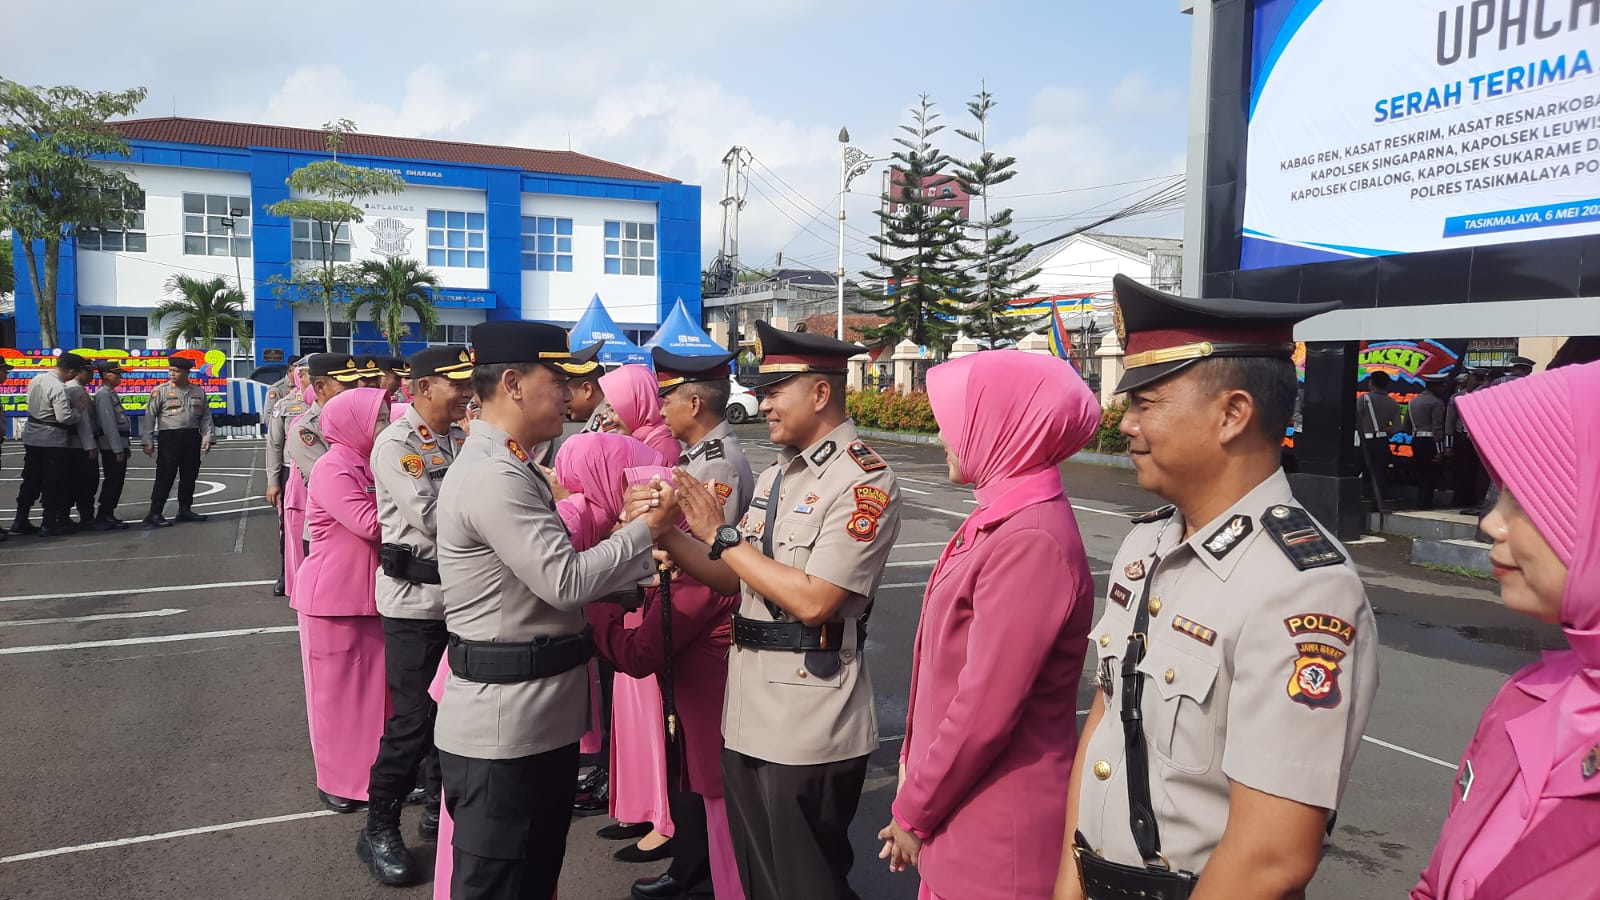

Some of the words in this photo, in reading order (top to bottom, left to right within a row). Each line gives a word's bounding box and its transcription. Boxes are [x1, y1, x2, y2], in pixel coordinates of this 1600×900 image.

[1374, 81, 1462, 123] SERAH
[1469, 49, 1593, 101] TERIMA
[1280, 154, 1315, 171] KABAG
[1317, 150, 1342, 164] REN,
[1345, 140, 1383, 158] KASAT
[1384, 127, 1445, 150] RESKRIM,
[1448, 117, 1493, 138] KASAT
[1311, 161, 1370, 181] KAPOLSEK
[1372, 145, 1458, 170] SINGAPARNA,
[1461, 128, 1539, 154] KAPOLSEK
[1291, 183, 1348, 202] KAPOLSEK
[1350, 171, 1415, 192] CIBALONG,
[1418, 157, 1490, 180] KAPOLSEK
[1493, 141, 1582, 166] SUKARAME
[1587, 138, 1600, 152] D
[1410, 181, 1462, 200] POLRES
[1465, 164, 1571, 192] TASIKMALAYA
[1464, 212, 1542, 230] TASIKMALAYA,
[1545, 210, 1553, 221] 6
[1555, 207, 1580, 220] MEI
[1360, 348, 1426, 374] UKSES
[1288, 615, 1353, 640] POLDA
